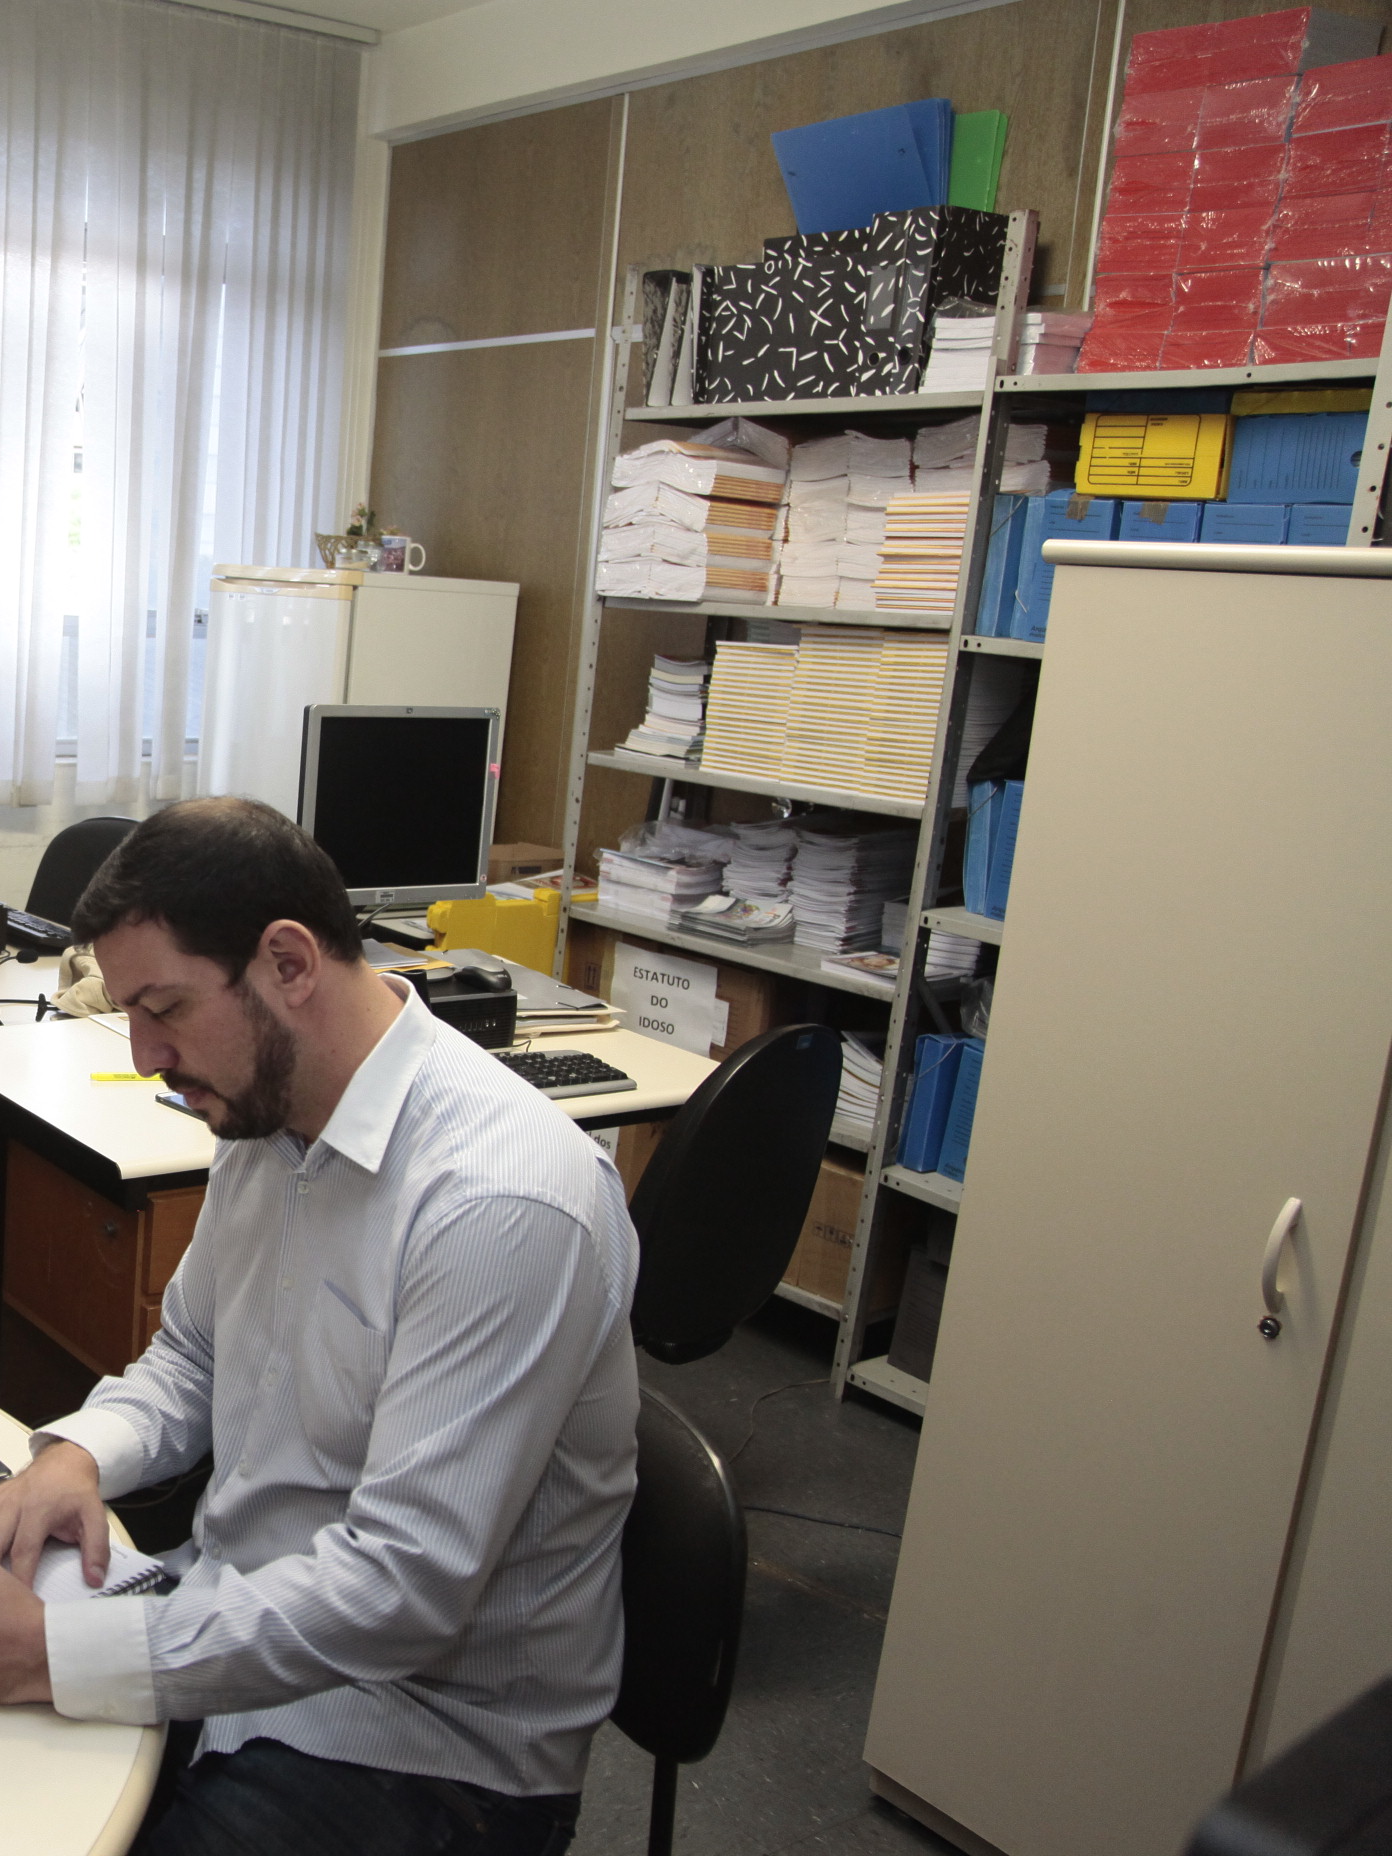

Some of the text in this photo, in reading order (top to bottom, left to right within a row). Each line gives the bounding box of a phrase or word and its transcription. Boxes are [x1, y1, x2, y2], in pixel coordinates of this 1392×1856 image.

[633, 966, 690, 990] ESTATUTO
[650, 995, 669, 1009] DO
[639, 1015, 675, 1035] IDOSO
